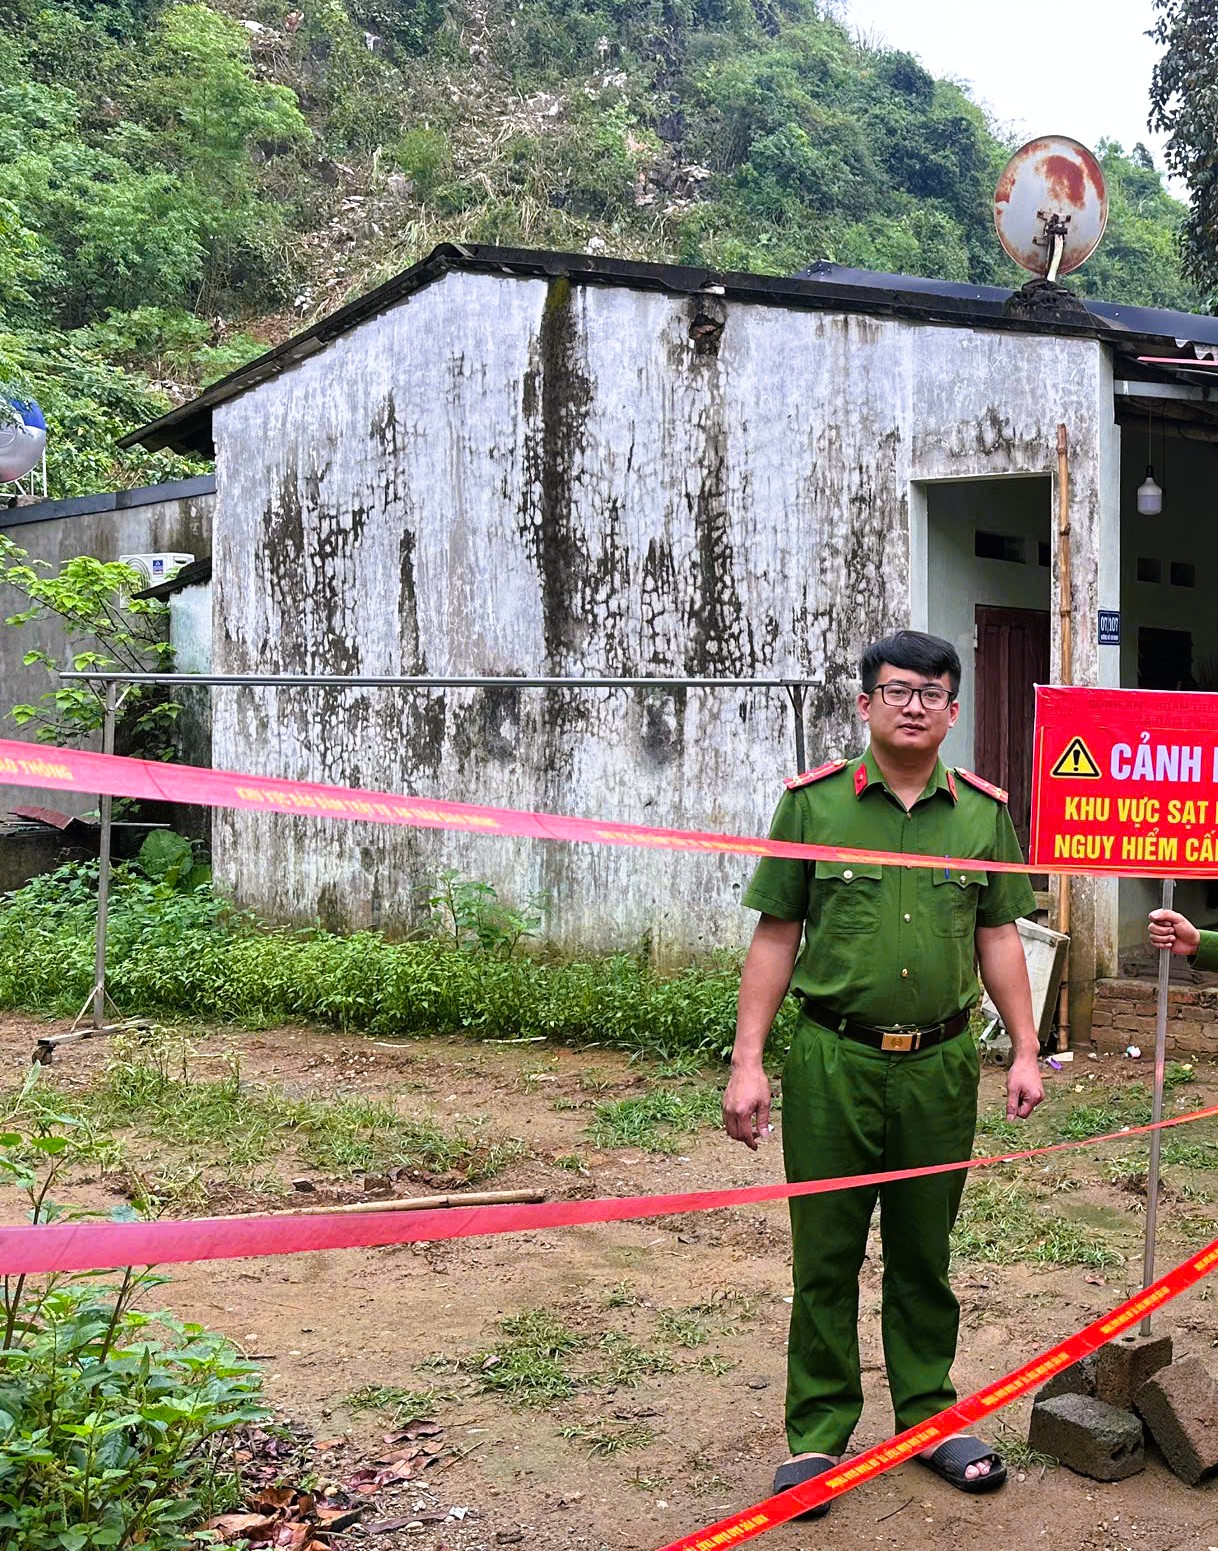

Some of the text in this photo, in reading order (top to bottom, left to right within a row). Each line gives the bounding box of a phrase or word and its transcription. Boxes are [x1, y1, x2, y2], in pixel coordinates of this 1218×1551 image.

[1110, 732, 1201, 782] CẢNH
[1065, 796, 1109, 821] KHU
[1118, 797, 1160, 828] VỰC
[1168, 800, 1208, 829] SẠT
[1054, 834, 1114, 859] NGUY
[1122, 827, 1177, 860] HIỂM
